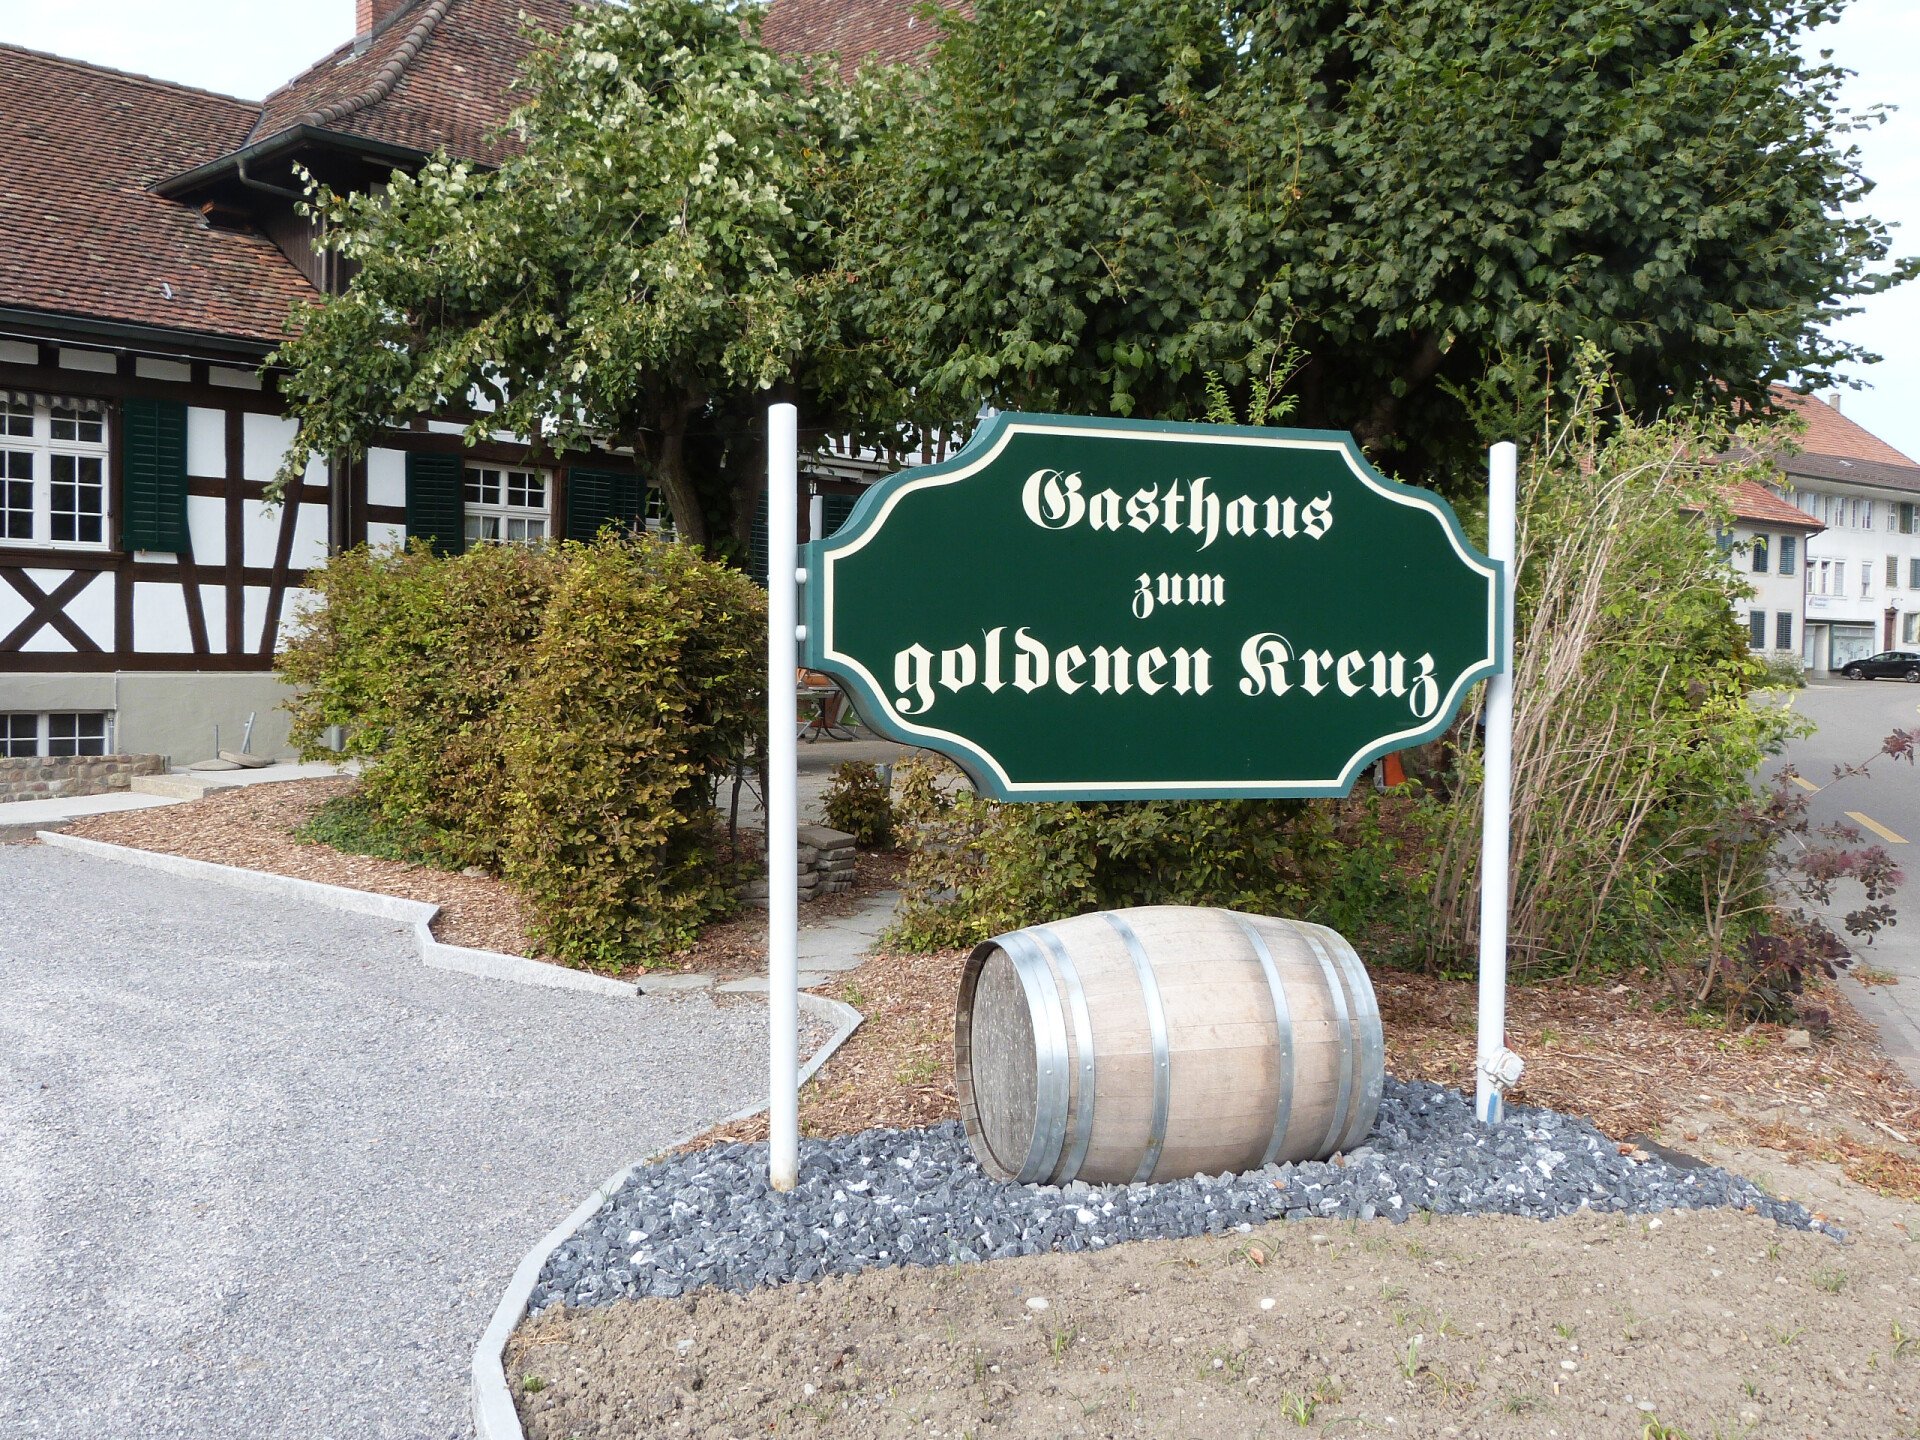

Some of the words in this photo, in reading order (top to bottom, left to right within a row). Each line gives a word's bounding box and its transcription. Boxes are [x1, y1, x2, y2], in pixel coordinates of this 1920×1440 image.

[1021, 468, 1333, 553] Gasthaus
[1131, 572, 1226, 619] zum
[894, 626, 1214, 715] goldenen
[1239, 632, 1439, 718] Kreuz
